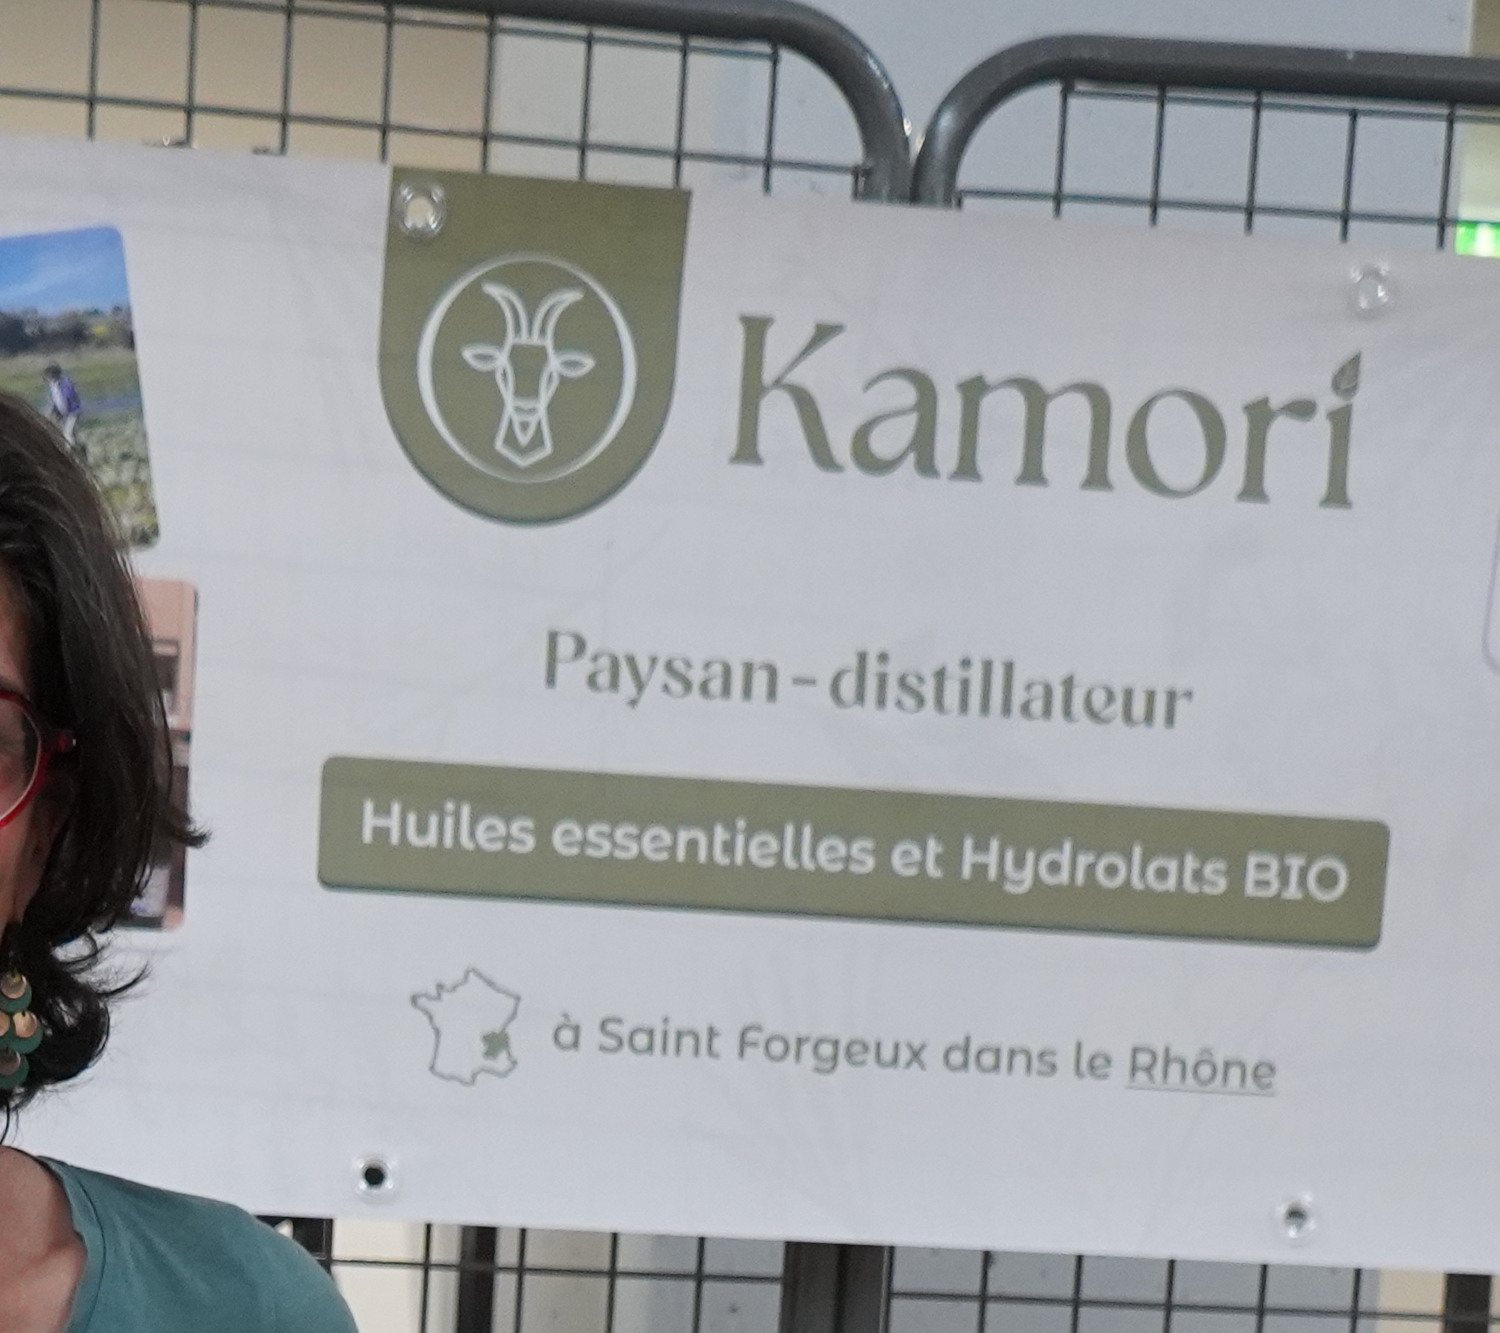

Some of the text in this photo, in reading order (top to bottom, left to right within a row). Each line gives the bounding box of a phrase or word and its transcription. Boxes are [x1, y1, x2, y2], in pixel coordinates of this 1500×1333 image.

[729, 313, 1361, 509] Kamori
[361, 798, 1350, 903] Huiles essentielles et Hydrolats BIO
[552, 1012, 1278, 1093] à Saint Forgeux dans le Rhône
